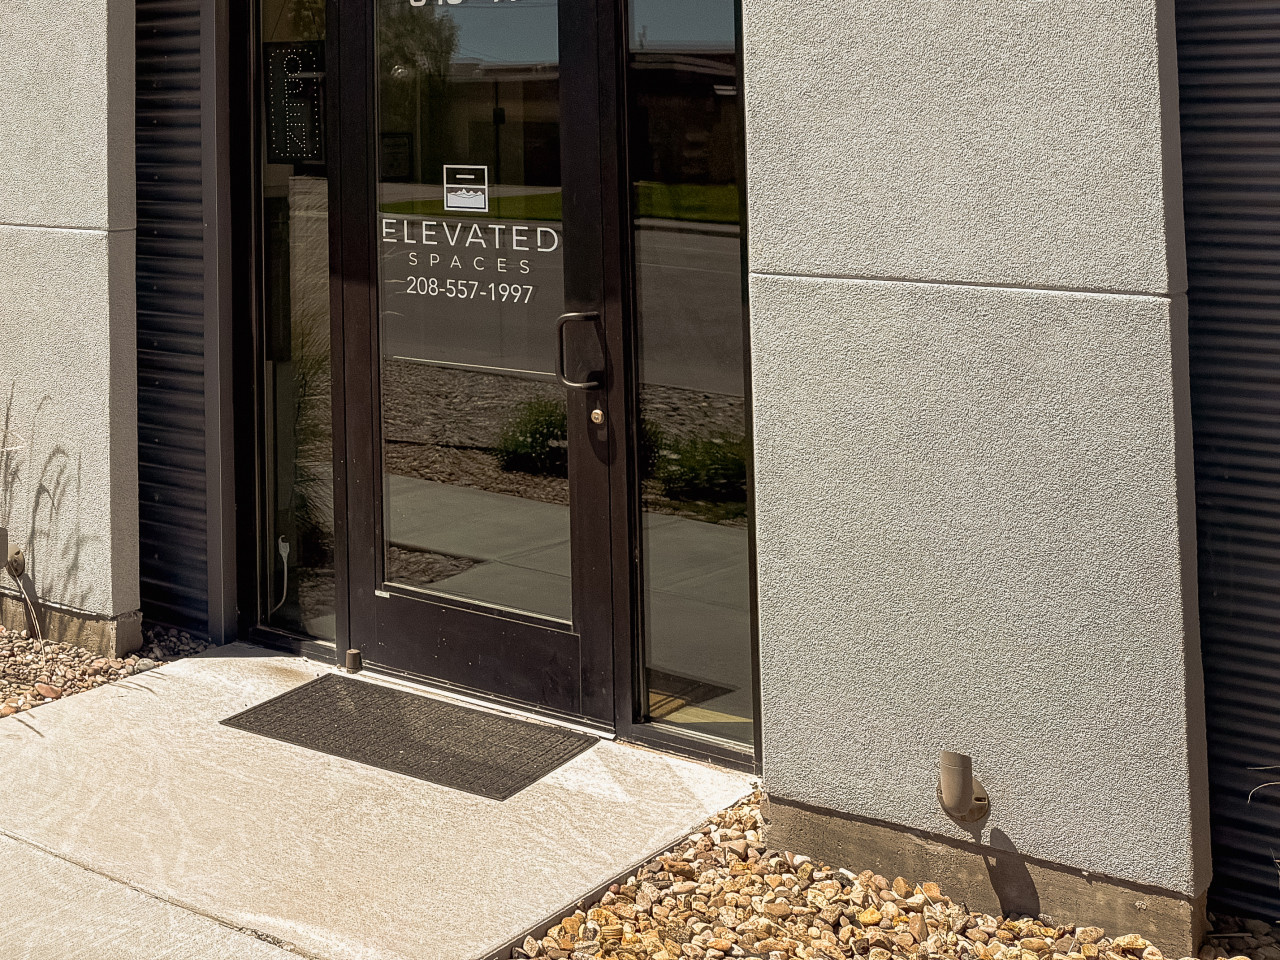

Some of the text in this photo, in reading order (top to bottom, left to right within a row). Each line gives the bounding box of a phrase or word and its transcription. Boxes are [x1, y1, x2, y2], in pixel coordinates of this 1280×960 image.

[283, 54, 306, 151] OPEN
[382, 218, 559, 252] ELEVATED
[408, 252, 530, 274] SPACES
[406, 276, 533, 304] 208-557-1997
